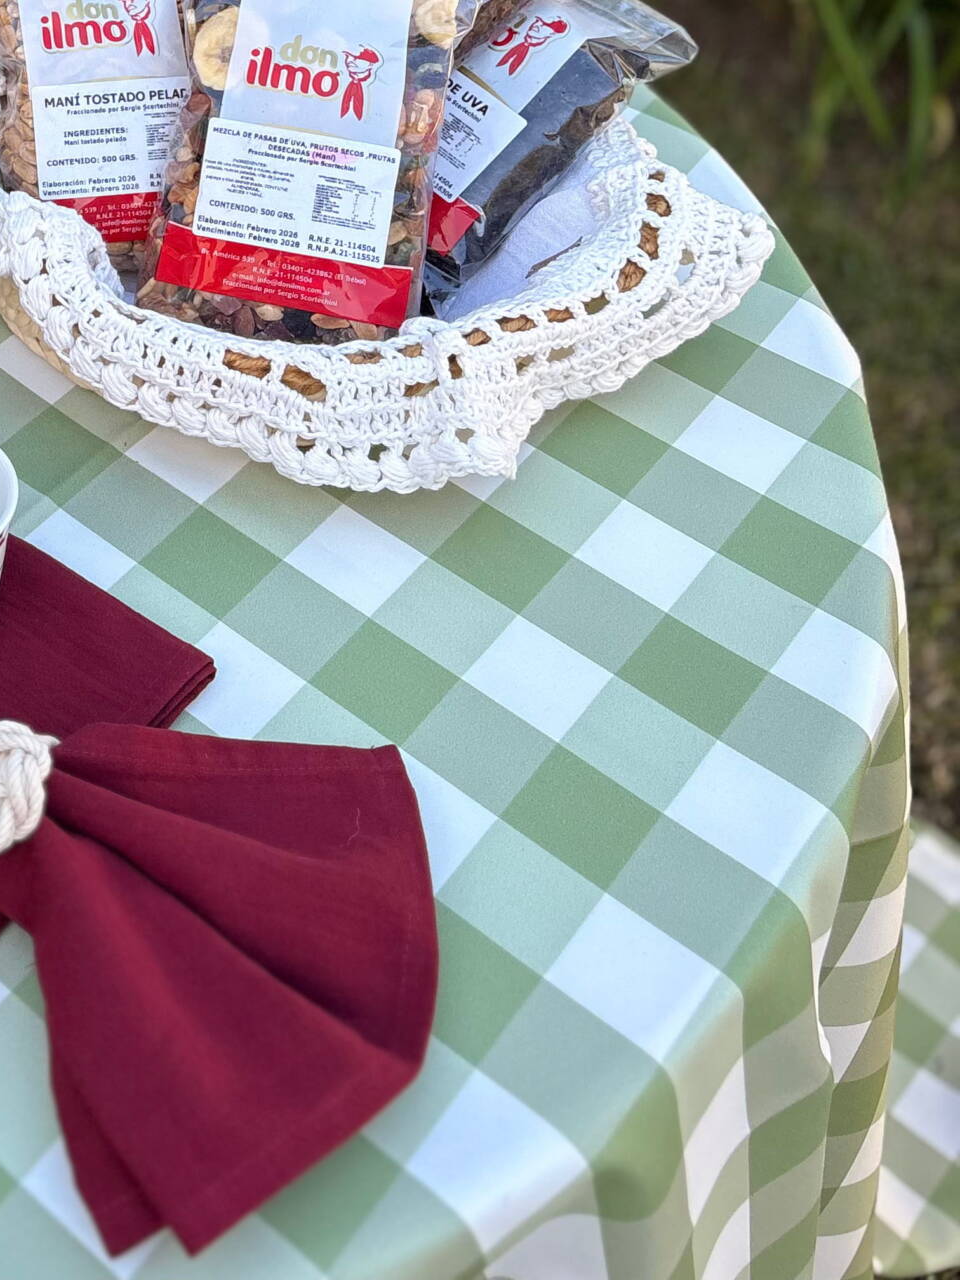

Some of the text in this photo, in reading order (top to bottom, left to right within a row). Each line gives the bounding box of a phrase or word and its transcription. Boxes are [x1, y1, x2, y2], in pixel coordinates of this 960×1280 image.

[40, 11, 127, 50] ilmo
[279, 35, 338, 69] don
[245, 46, 341, 98] ilmo
[44, 92, 79, 108] MANÍ
[84, 91, 145, 105] TOSTADO
[66, 107, 106, 115] Fraccionado
[120, 104, 141, 112] Sergio
[450, 96, 481, 125] Scortechini
[460, 88, 490, 118] UVA
[63, 127, 128, 137] INGREDIENTES:
[105, 135, 126, 143] pelado
[212, 126, 241, 136] MEZCLA
[254, 133, 277, 143] PASAS
[278, 137, 289, 145] DE
[289, 139, 307, 149] UVA,
[309, 142, 338, 153] FRUTOS
[340, 148, 364, 158] SECOS
[46, 156, 99, 167] CONTENIDO:
[101, 155, 116, 163] 500
[247, 148, 356, 172] Fraccionado por Sergio Scortechini
[268, 143, 336, 162] DESECADAS (Maní)
[42, 178, 86, 188] Elaboración:
[88, 176, 116, 184] Febrero
[42, 187, 89, 196] Vencimiento:
[91, 184, 120, 192] Febrero
[208, 198, 296, 220] CONTENIDO: 500 GRS.
[196, 224, 300, 248] Vencimiento: Febrero 2028
[197, 214, 298, 238] Elaboración: Febrero 2026
[308, 234, 376, 253] R.N.E. 21-114504
[212, 249, 241, 261] América
[281, 263, 333, 279] 03401-423862
[256, 276, 331, 297] info@donilmo.com.ar
[274, 270, 313, 284] 21-114504
[222, 278, 339, 307] Fraccionado por Sergio Scortechini
